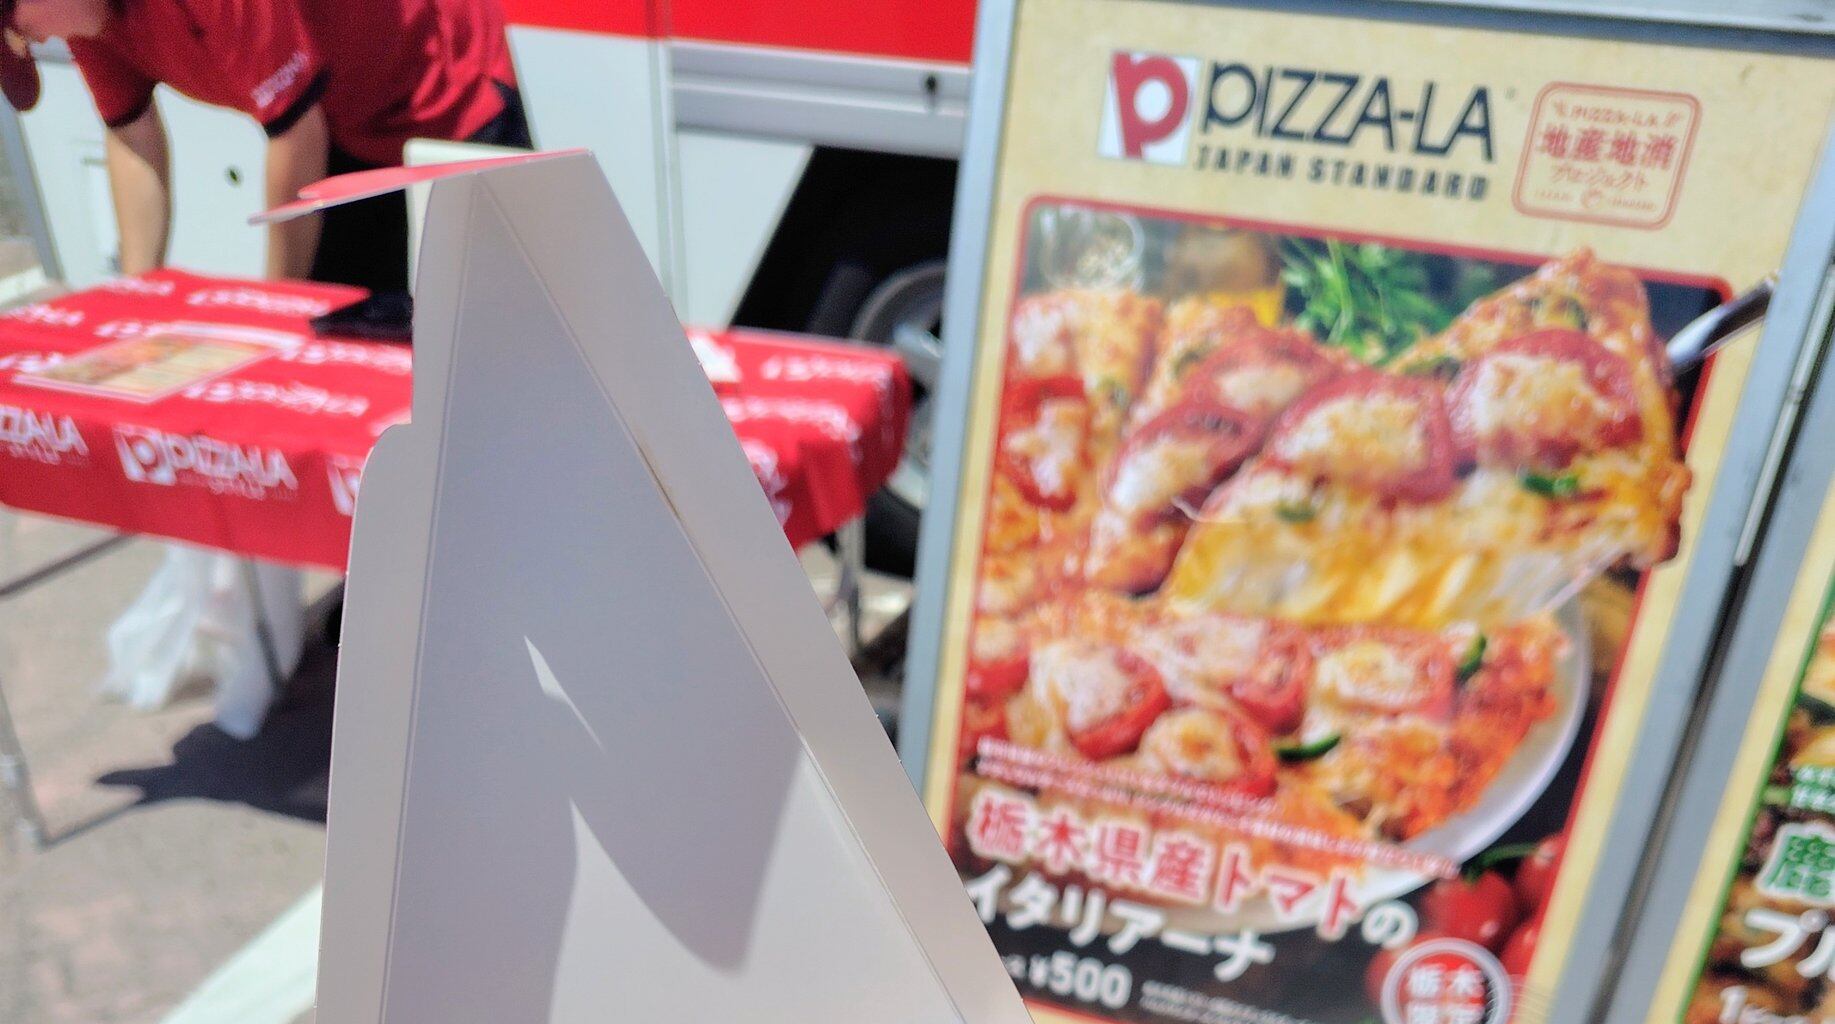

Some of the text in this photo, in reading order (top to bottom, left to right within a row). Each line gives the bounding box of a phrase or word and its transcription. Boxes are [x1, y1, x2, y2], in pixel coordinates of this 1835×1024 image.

[1195, 145, 1489, 202] JAPAN STANDARD
[1539, 123, 1678, 171] 地産地消
[966, 865, 1275, 984] イタリアーナ
